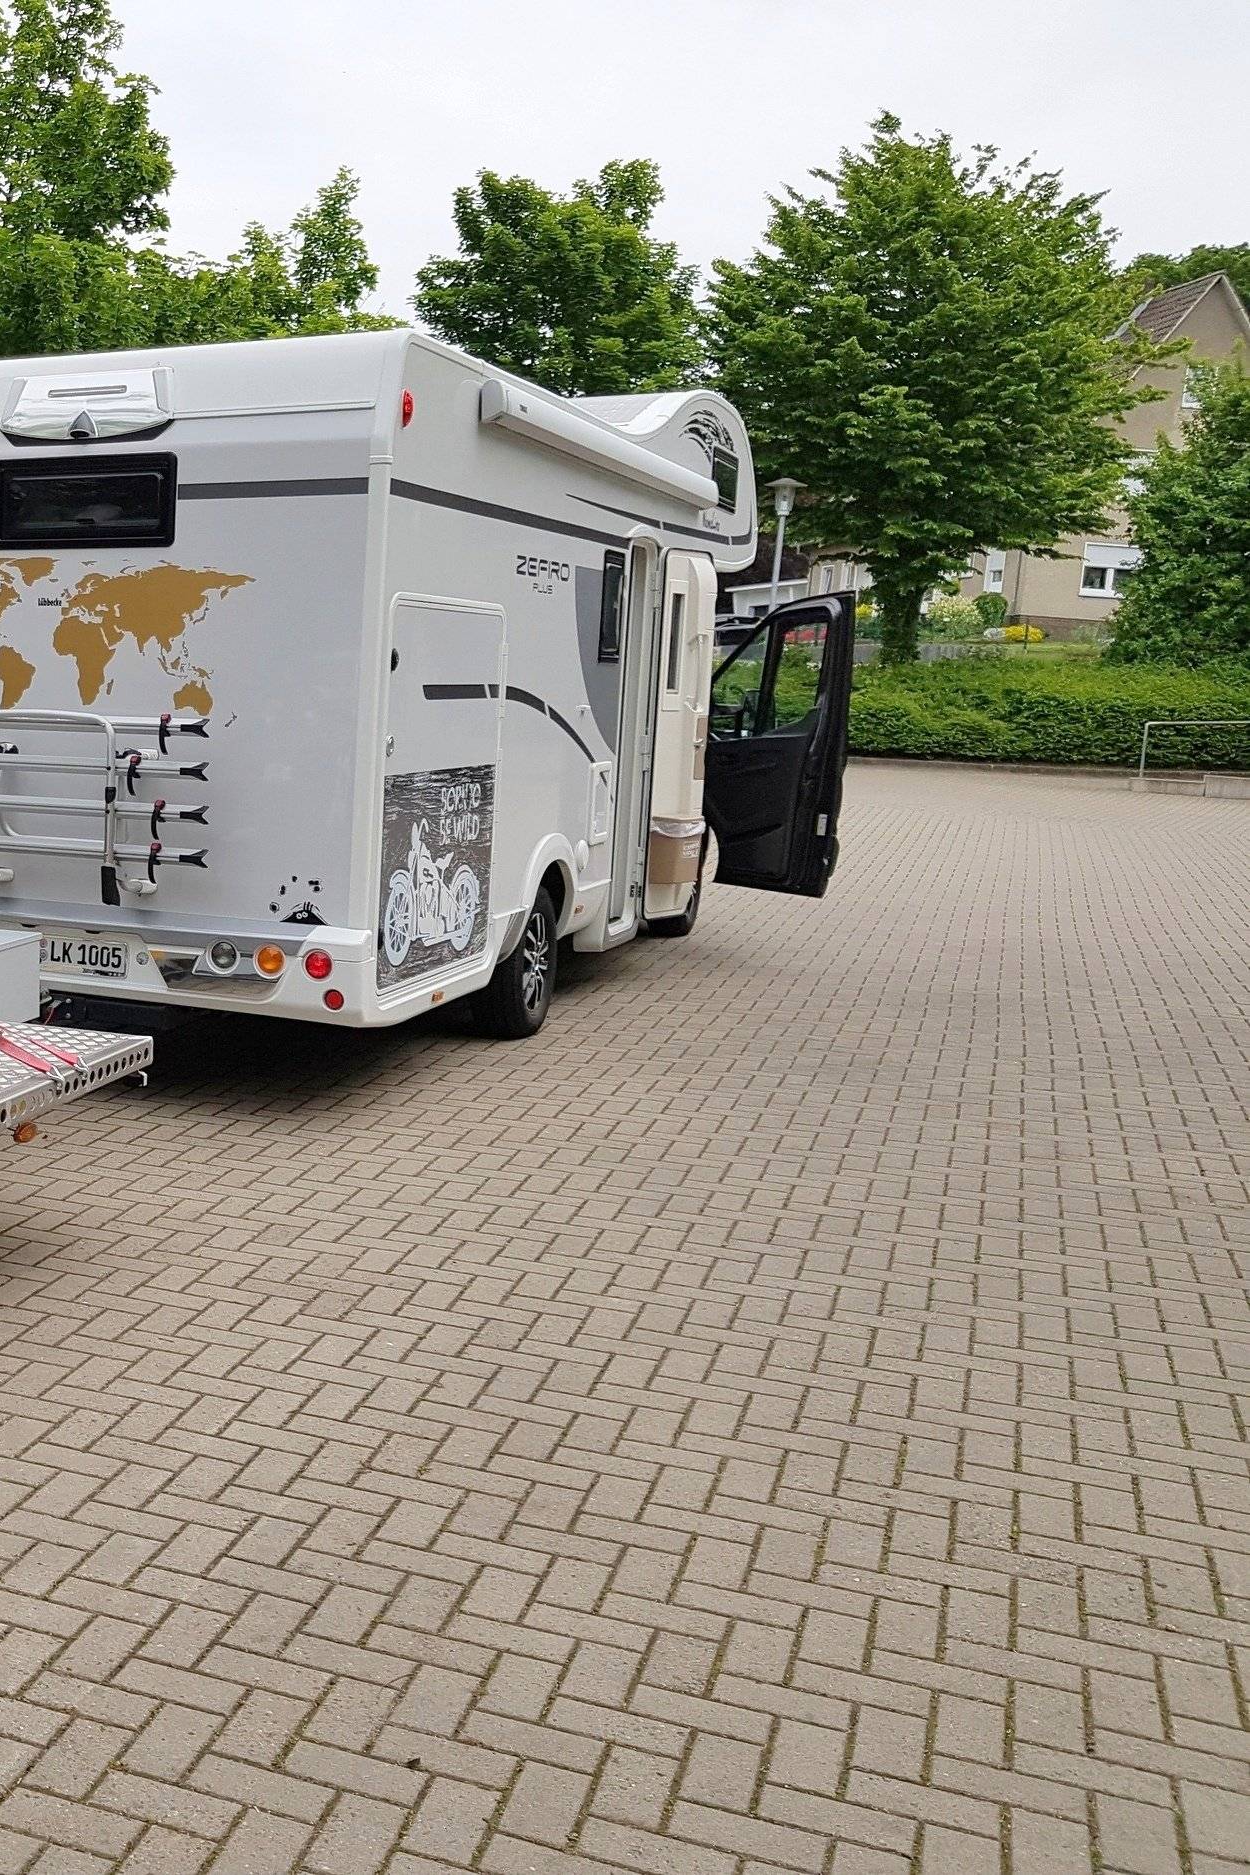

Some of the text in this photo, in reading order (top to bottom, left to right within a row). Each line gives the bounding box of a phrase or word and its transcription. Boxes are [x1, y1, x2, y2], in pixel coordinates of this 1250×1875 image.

[516, 554, 570, 582] ZEFIRO
[51, 941, 122, 969] LK 1005
